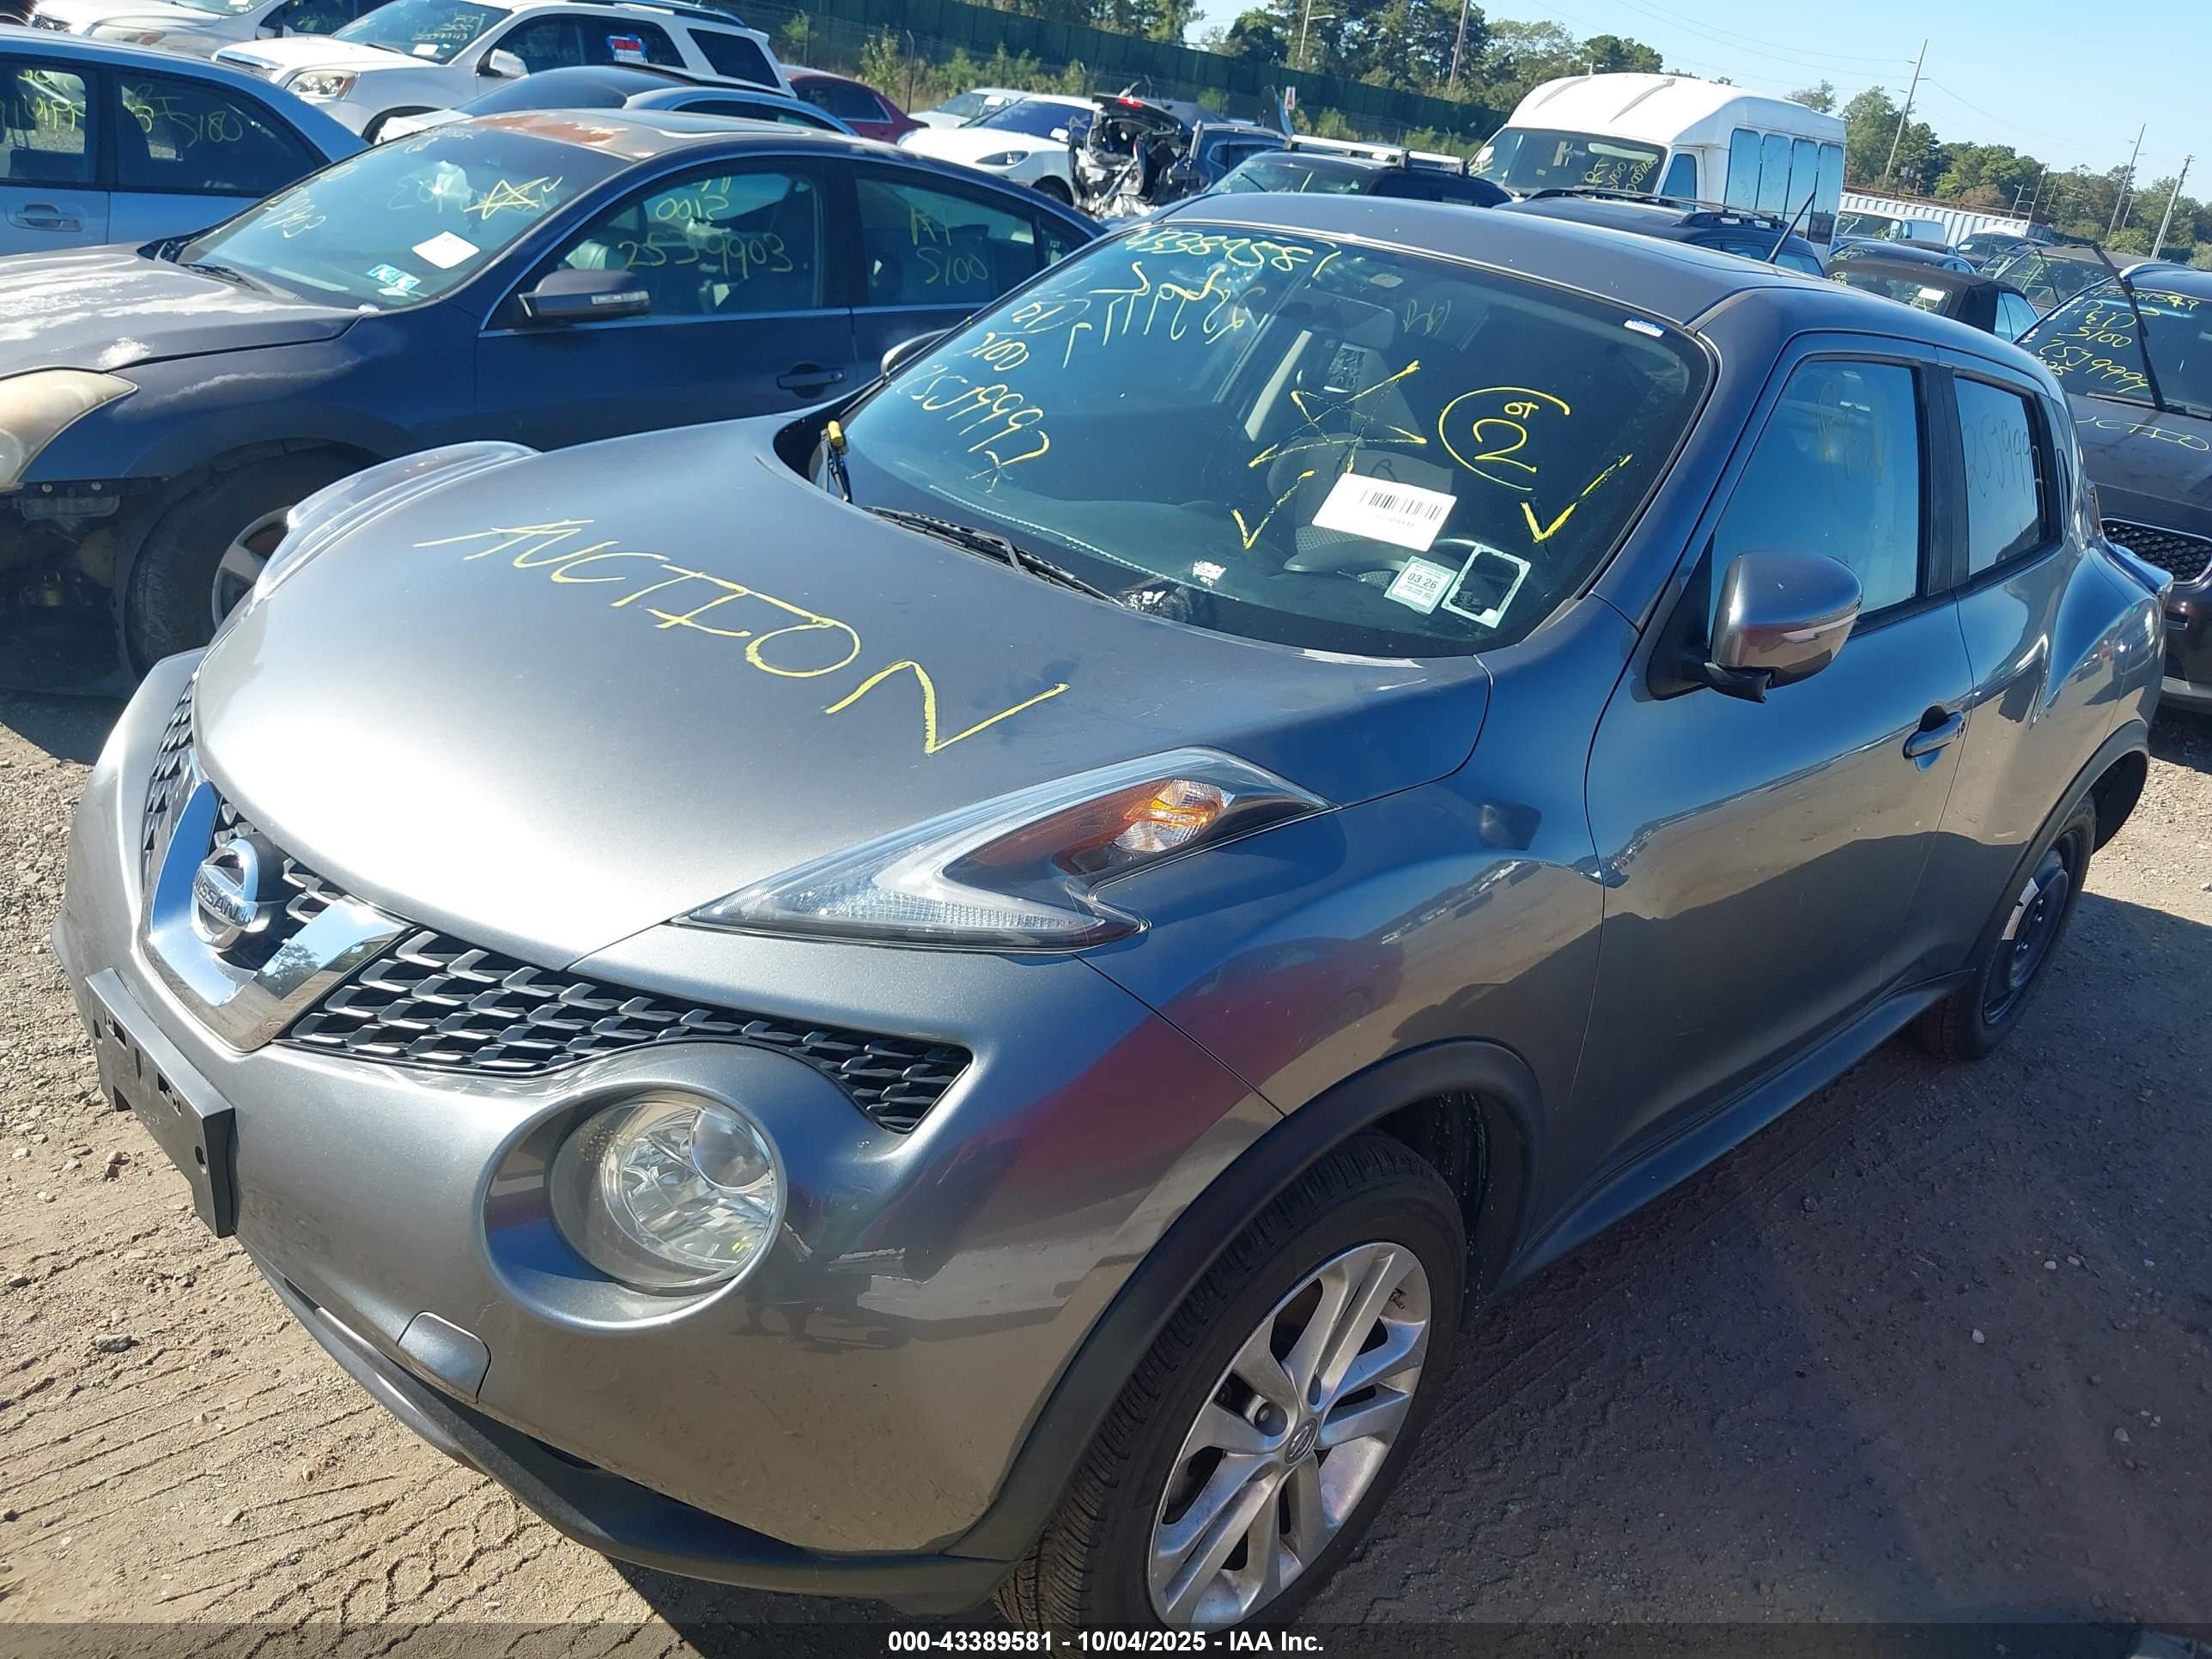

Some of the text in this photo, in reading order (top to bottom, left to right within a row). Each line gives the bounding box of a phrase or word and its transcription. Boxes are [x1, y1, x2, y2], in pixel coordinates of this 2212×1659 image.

[1472, 418, 1538, 473] 2
[412, 519, 1071, 755] AUCTION
[195, 874, 238, 923] NISSAN
